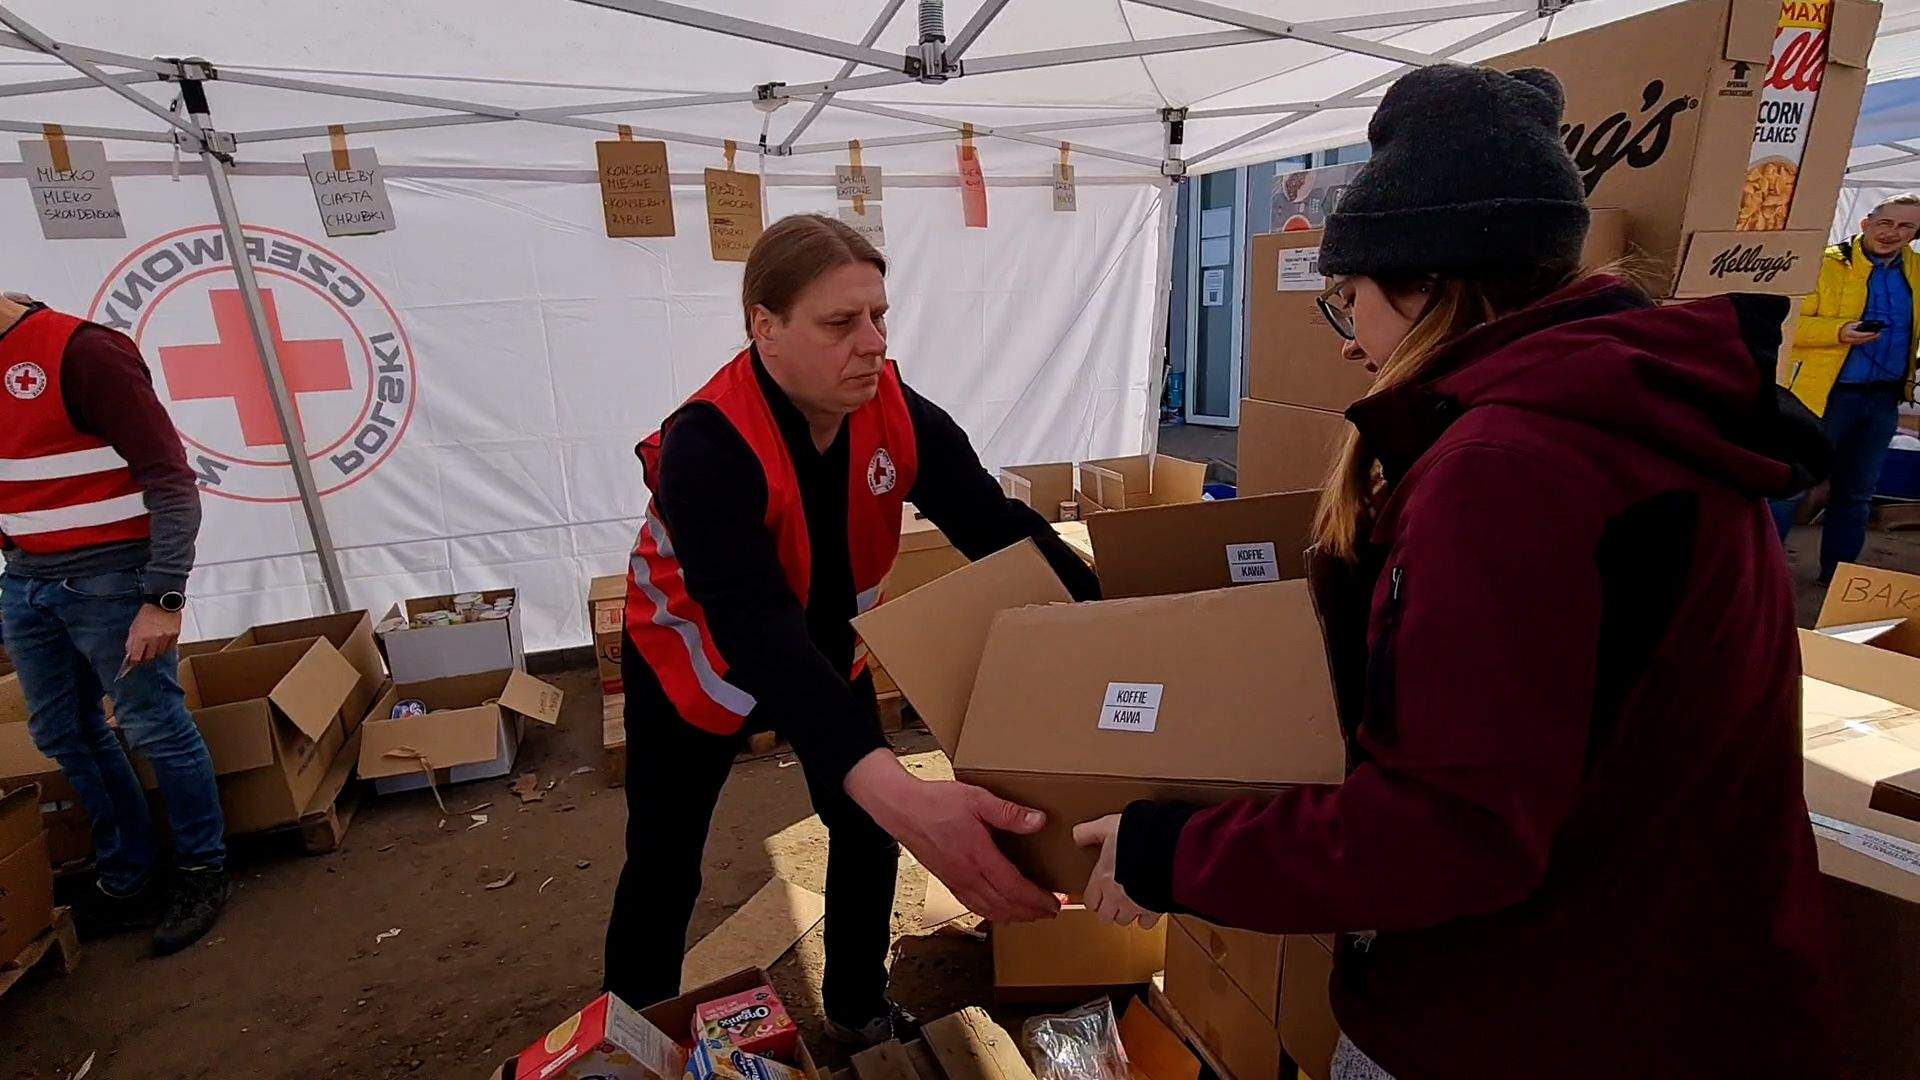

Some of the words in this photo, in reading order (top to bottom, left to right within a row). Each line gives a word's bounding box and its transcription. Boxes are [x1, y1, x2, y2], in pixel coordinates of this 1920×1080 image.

[1757, 101, 1804, 124] CORN
[1752, 126, 1798, 143] FLAKES
[37, 167, 95, 182] MLEKO
[315, 170, 374, 185] CHLEBY
[43, 191, 93, 205] MLEKO
[321, 190, 373, 206] CIASTA
[1709, 244, 1798, 283] Kellogg's
[1237, 548, 1265, 561] KOFFIE
[1241, 565, 1266, 577] KAWA
[1841, 577, 1920, 610] BAK
[1115, 690, 1148, 705] KOFFIE
[1113, 710, 1141, 725] KAWA
[719, 1005, 770, 1029] Organix
